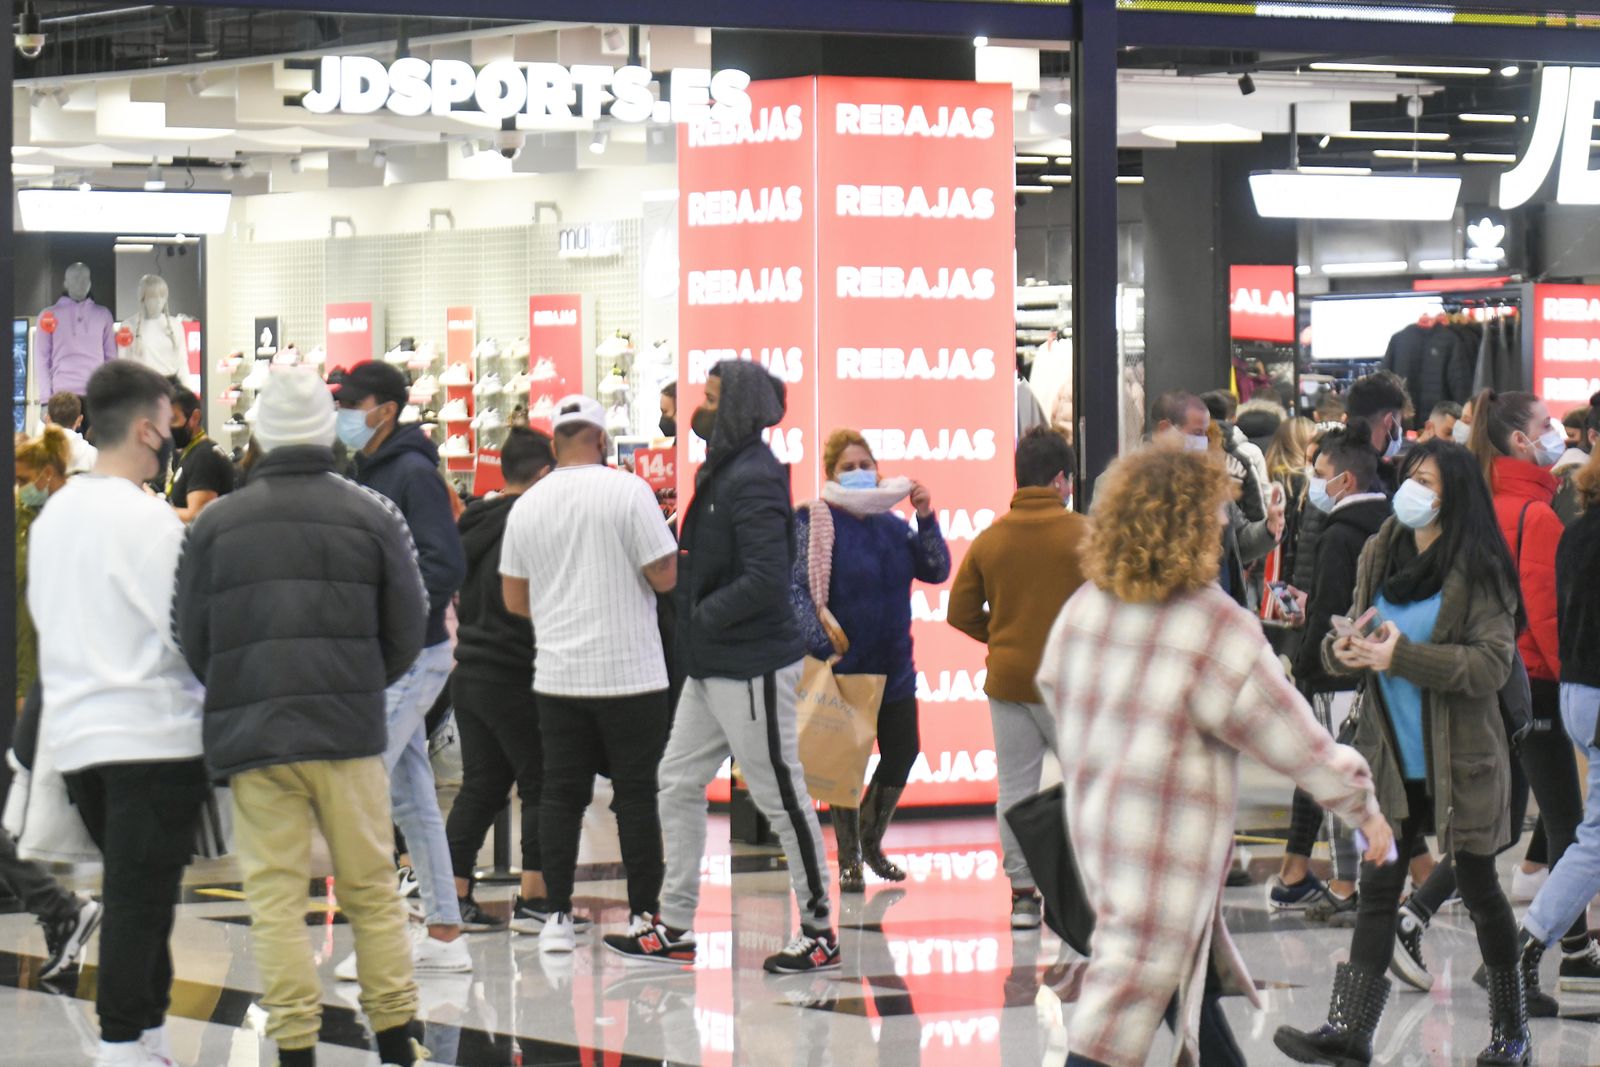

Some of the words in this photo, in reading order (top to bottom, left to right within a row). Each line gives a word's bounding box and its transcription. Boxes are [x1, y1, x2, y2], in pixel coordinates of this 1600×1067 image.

[303, 55, 751, 122] JDSPORTS.ES
[836, 103, 994, 138] REBAJAS
[687, 185, 803, 226] REBAJAS
[836, 185, 995, 219] REBAJAS
[687, 266, 803, 305] REBAJAS
[836, 266, 995, 299] REBAJAS
[836, 348, 995, 380] REBAJAS
[861, 429, 996, 461] EBAJAS
[638, 453, 674, 477] 14€
[915, 669, 988, 702] AJAS
[906, 750, 998, 784] AJAS
